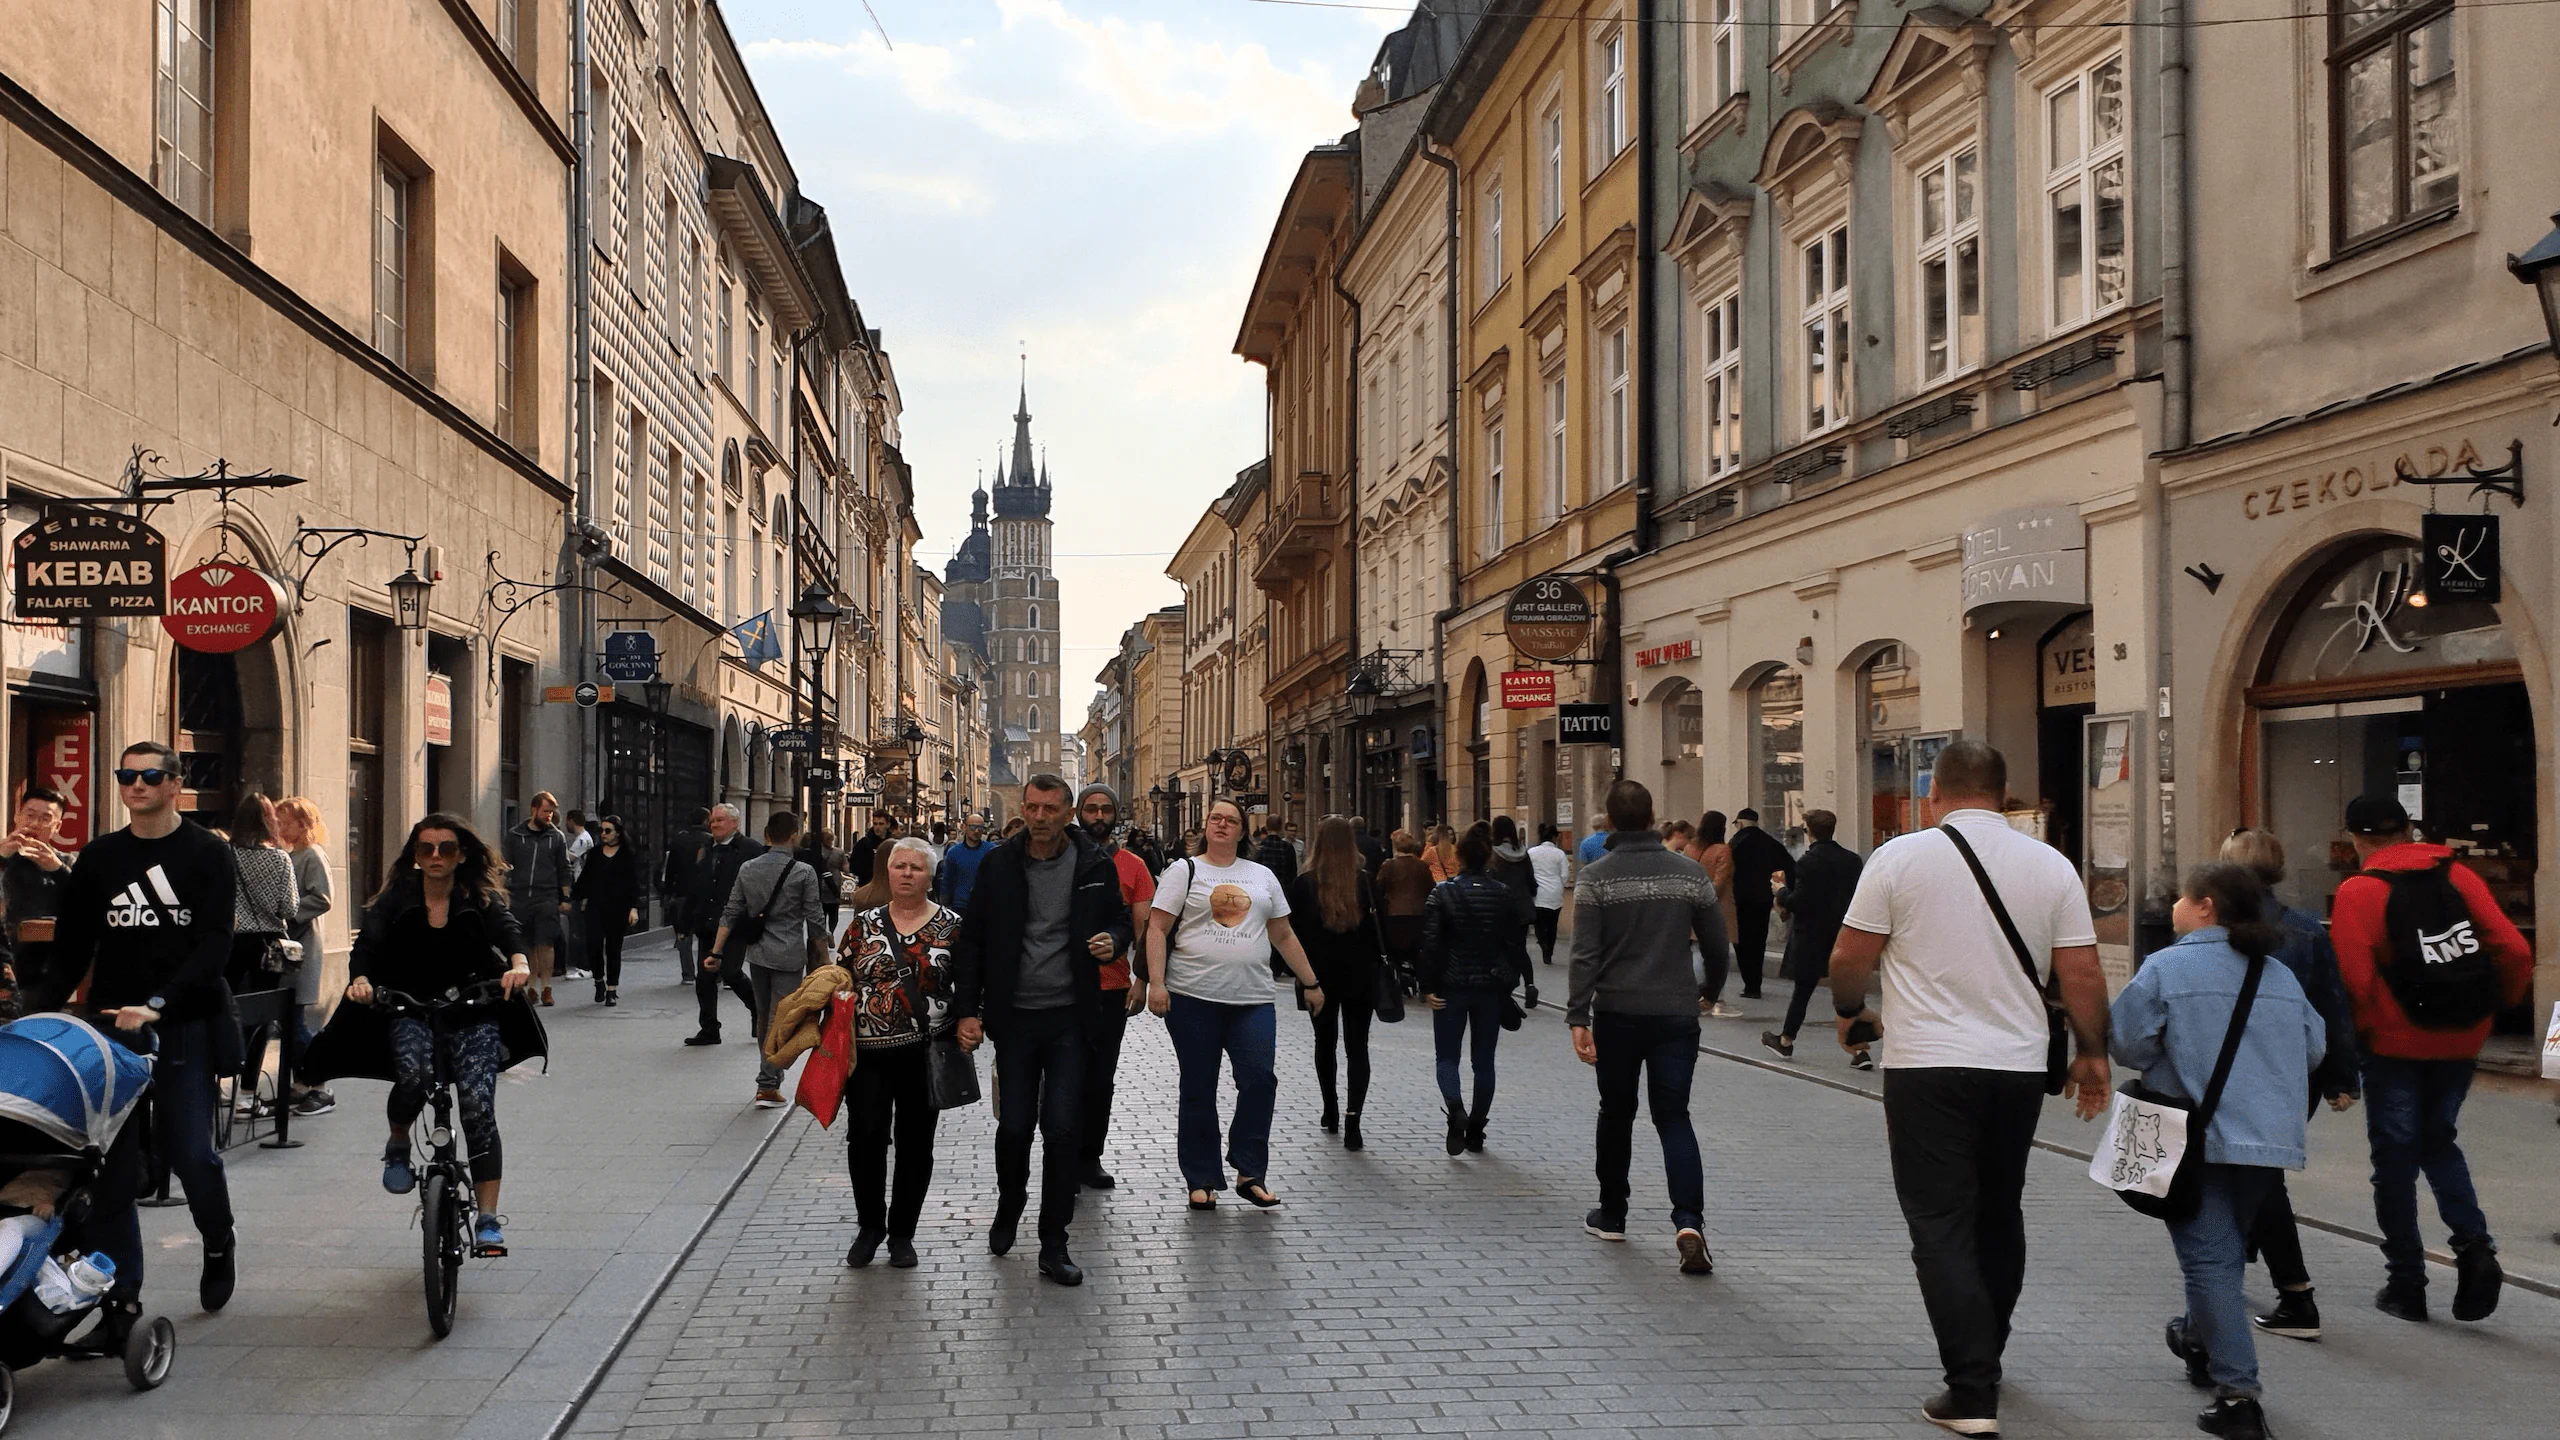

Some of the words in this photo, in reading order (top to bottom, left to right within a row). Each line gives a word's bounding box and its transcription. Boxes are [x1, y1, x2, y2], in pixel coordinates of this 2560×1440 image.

[2244, 438, 2484, 520] CZEKOLADA
[18, 516, 161, 549] BEIRUT
[49, 540, 131, 552] SHAWARMA
[1964, 527, 2011, 560] OTEL
[27, 560, 154, 587] KEBAB
[1963, 560, 2055, 601] ORYAN
[1535, 581, 1562, 599] 36
[26, 598, 92, 609] FALAFEL
[110, 596, 155, 607] PIZZA
[173, 595, 264, 616] KANTOR
[402, 597, 416, 612] 51
[1514, 603, 1535, 612] ART
[1537, 603, 1583, 612] GALLERY
[1511, 614, 1545, 622] OPRAWA
[186, 623, 252, 635] EXCHANGE
[1519, 627, 1577, 638] MASSAGE
[1505, 675, 1552, 686] KANTOR
[1506, 693, 1552, 703] EXCHANGE
[1561, 716, 1611, 732] TATTO
[778, 740, 807, 748] OPTYK
[807, 769, 832, 780] PB
[847, 796, 874, 804] HOSTEL
[2417, 919, 2480, 964] VANS
